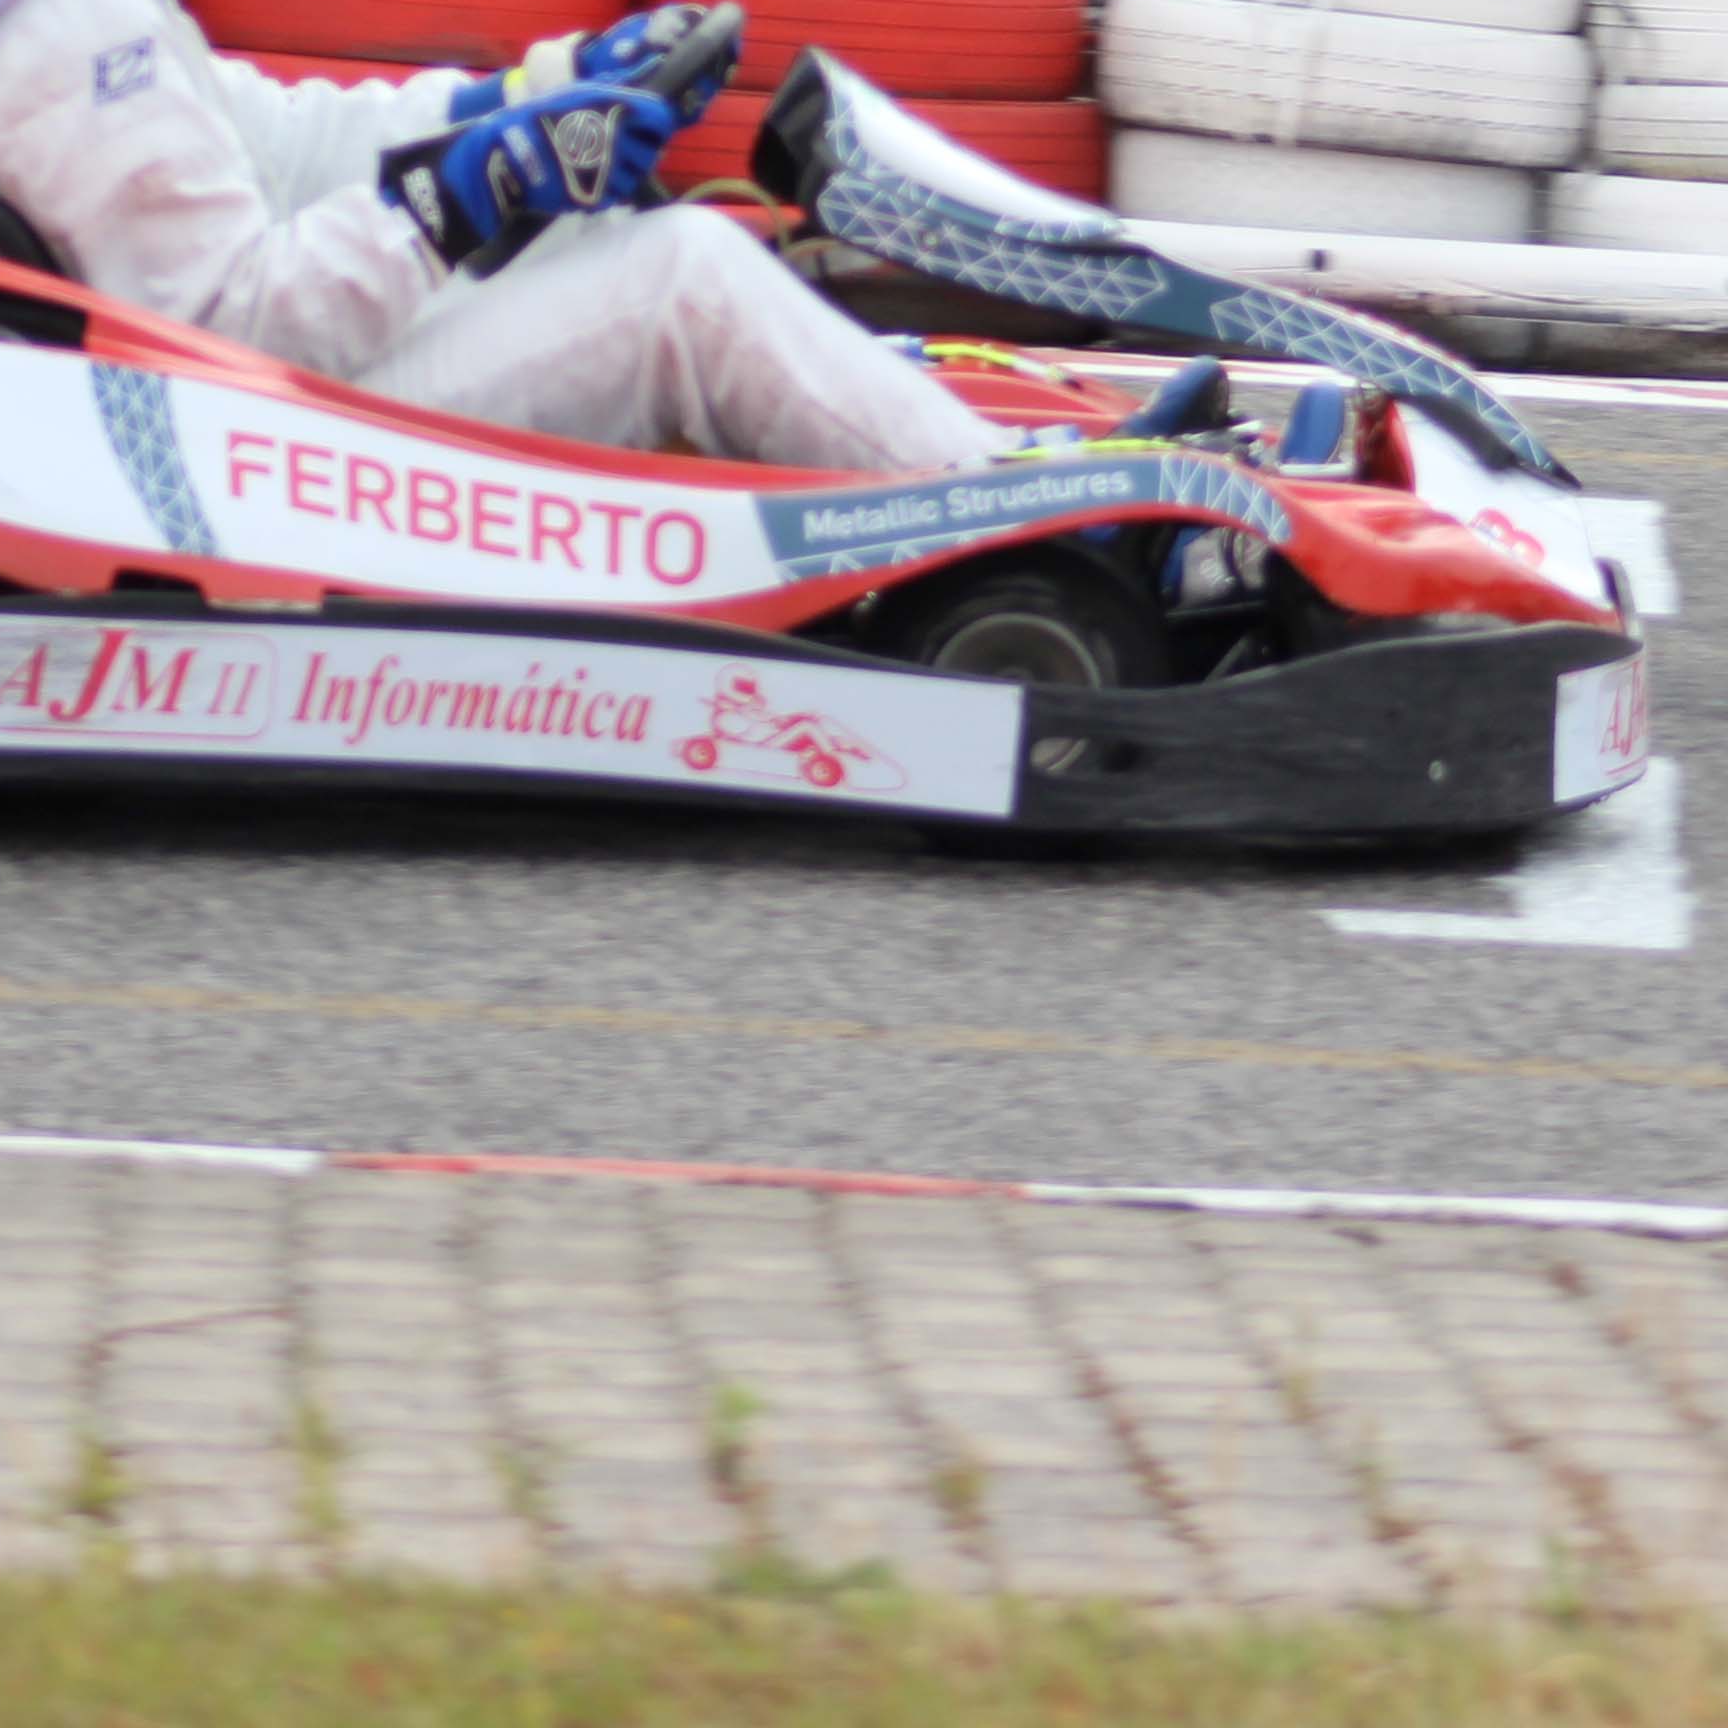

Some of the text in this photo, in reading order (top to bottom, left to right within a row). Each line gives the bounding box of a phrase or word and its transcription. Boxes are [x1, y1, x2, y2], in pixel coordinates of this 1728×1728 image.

[227, 430, 707, 587] FERBERTO
[802, 469, 1134, 543] Metallic Structures
[292, 652, 653, 746] Informática
